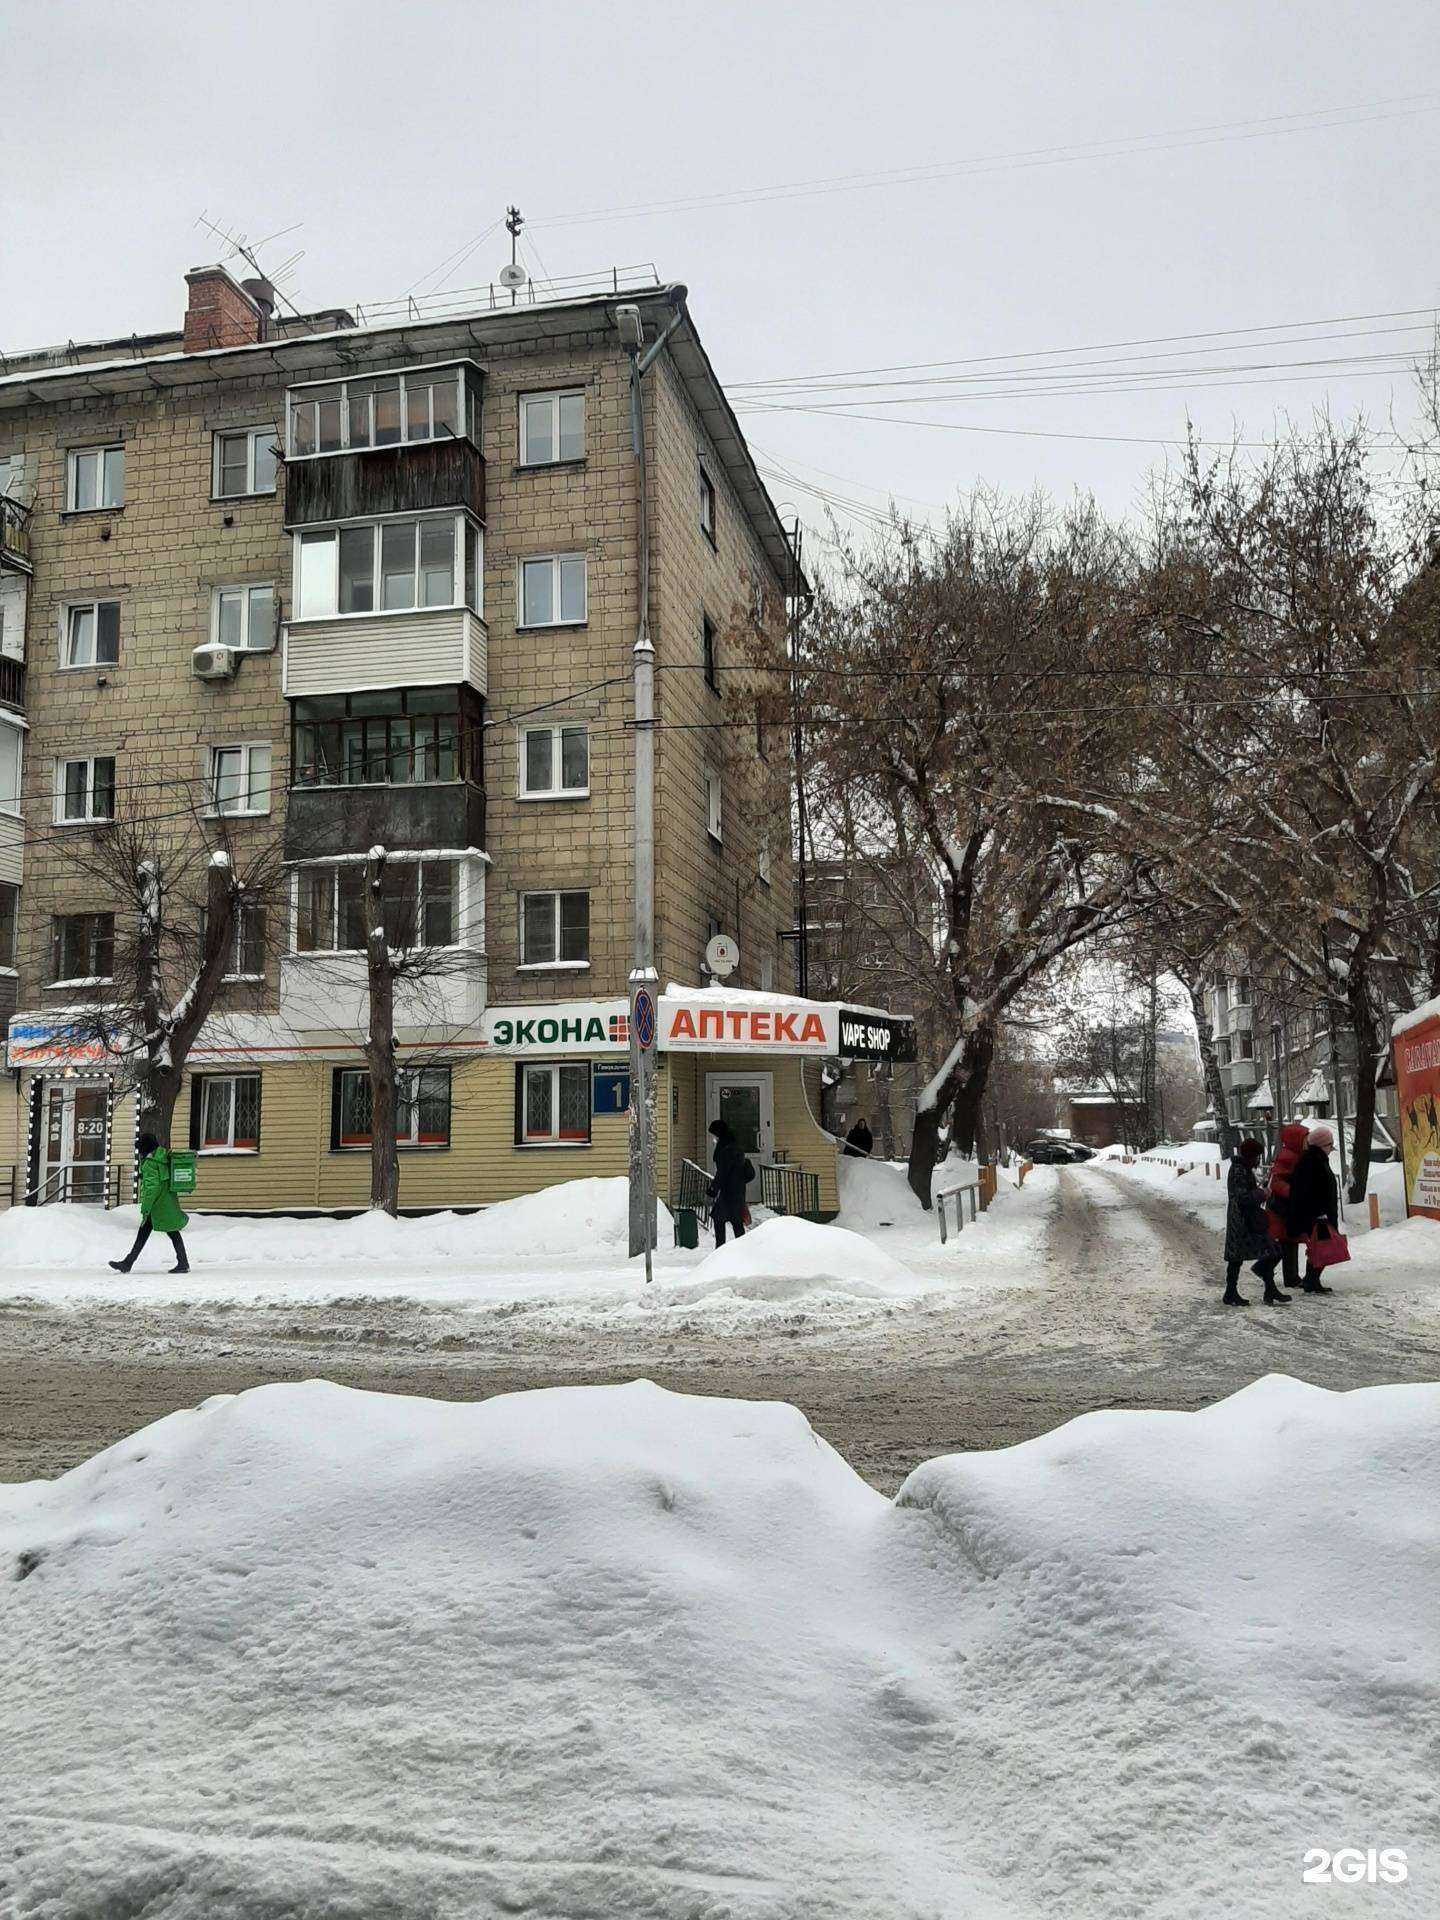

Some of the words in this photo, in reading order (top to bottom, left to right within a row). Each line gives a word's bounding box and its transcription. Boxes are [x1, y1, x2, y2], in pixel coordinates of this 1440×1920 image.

[493, 1016, 606, 1045] ЭКОНА
[668, 1009, 827, 1042] АПТЕКА
[842, 1021, 866, 1048] VAPE
[867, 1026, 891, 1051] SHOP
[612, 1082, 622, 1108] 1
